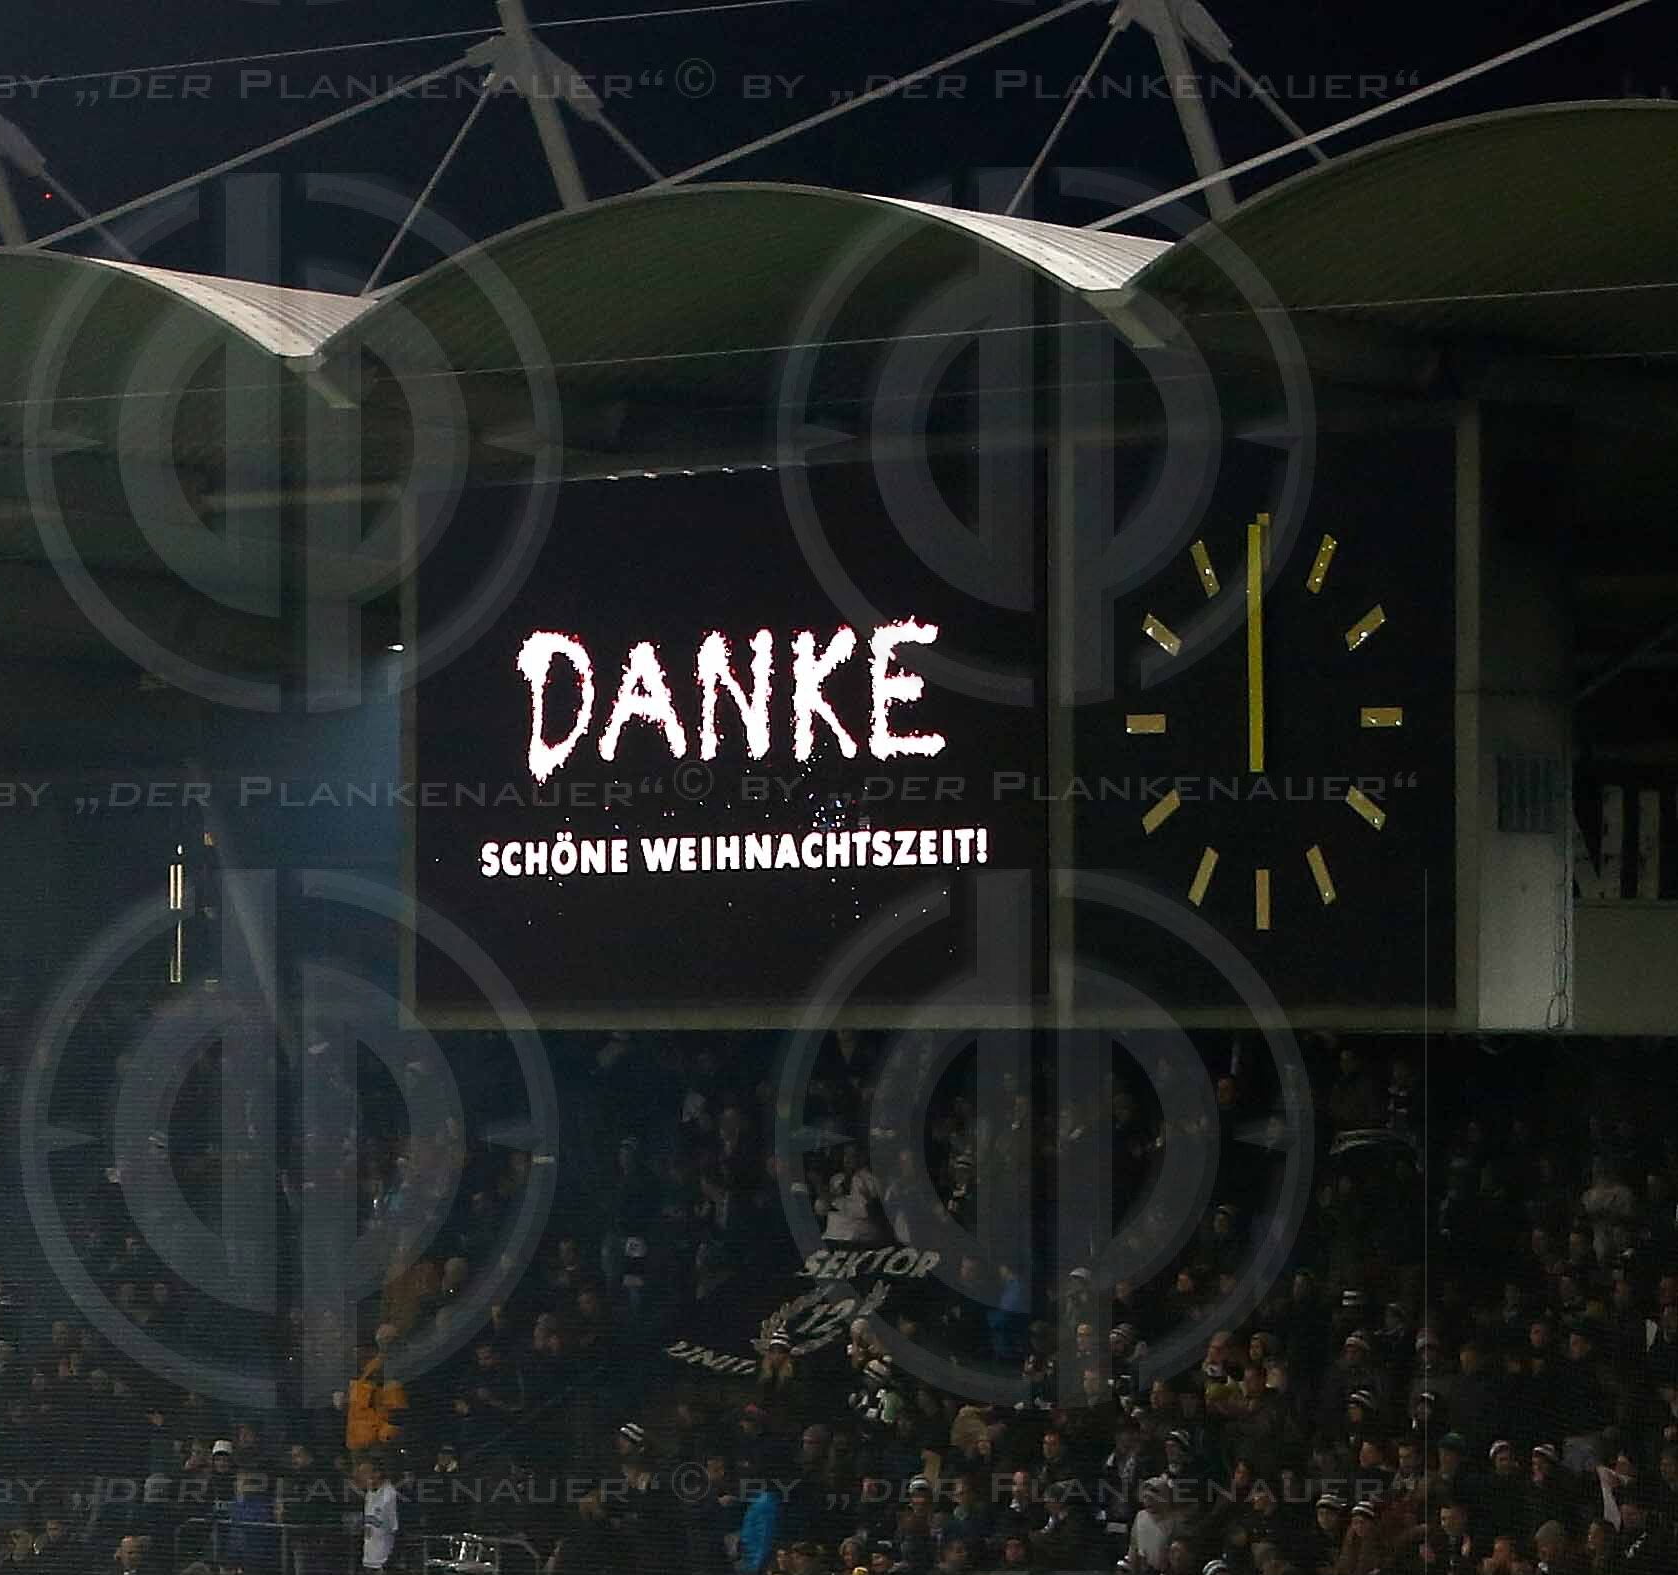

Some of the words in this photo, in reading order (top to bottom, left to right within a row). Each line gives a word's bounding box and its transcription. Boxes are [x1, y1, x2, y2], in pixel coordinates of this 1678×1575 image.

[516, 615, 946, 785] DANKE
[480, 831, 629, 878] SCHÖNE
[641, 826, 990, 873] WEIHNACHTSZEIT!
